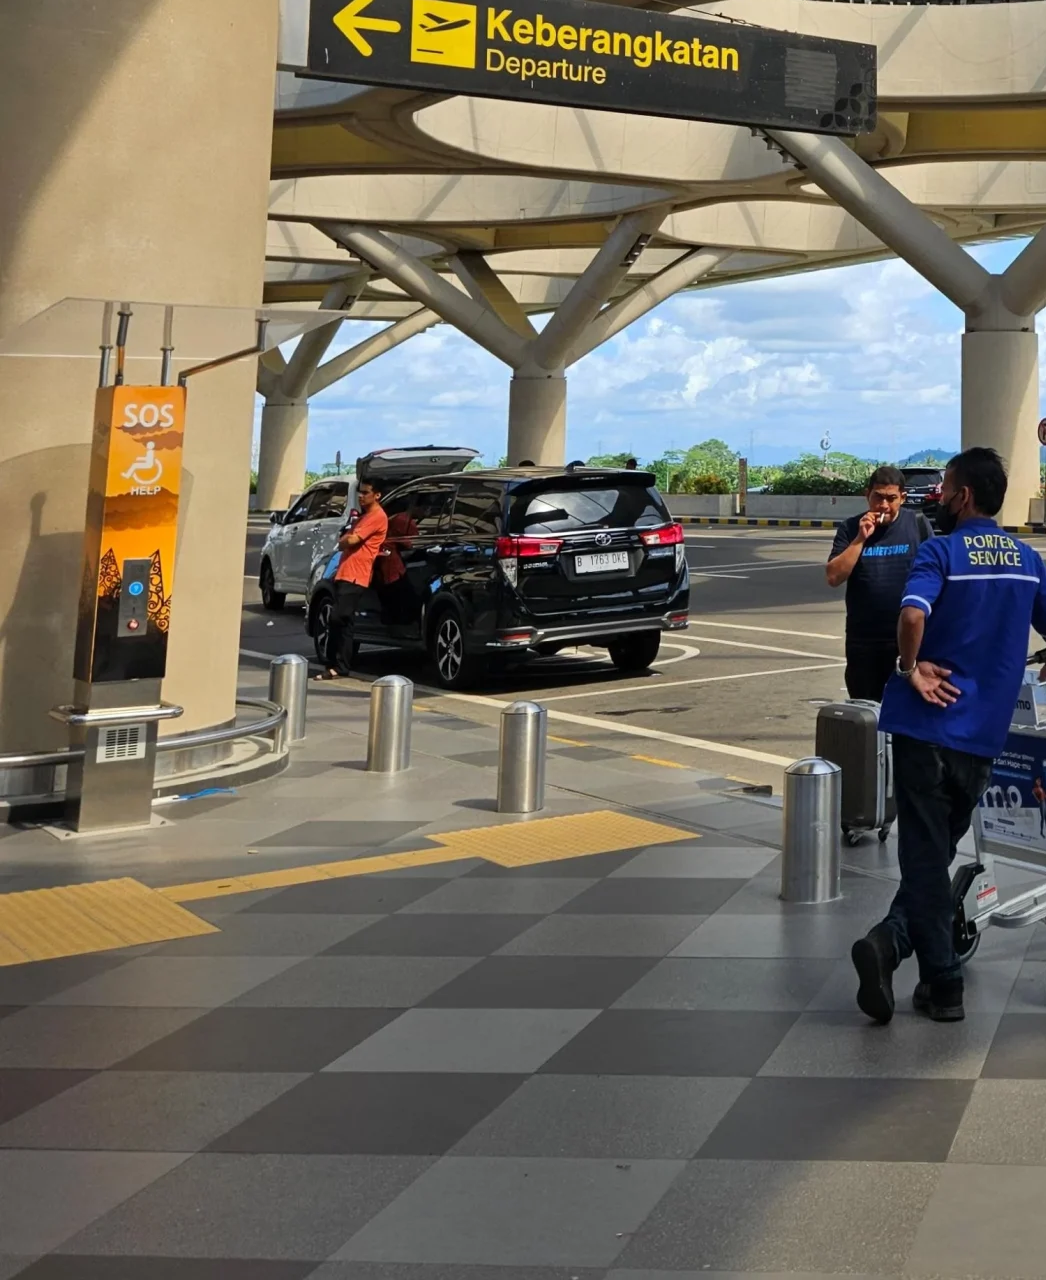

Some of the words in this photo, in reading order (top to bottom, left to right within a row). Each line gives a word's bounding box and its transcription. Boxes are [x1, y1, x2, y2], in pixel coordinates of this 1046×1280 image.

[486, 6, 740, 72] Keberangkatan
[486, 48, 607, 85] Departure
[123, 403, 174, 427] SOS
[130, 485, 161, 496] HELP
[963, 534, 1018, 550] PORTER
[861, 544, 910, 557] LANETSURF
[577, 556, 583, 567] B
